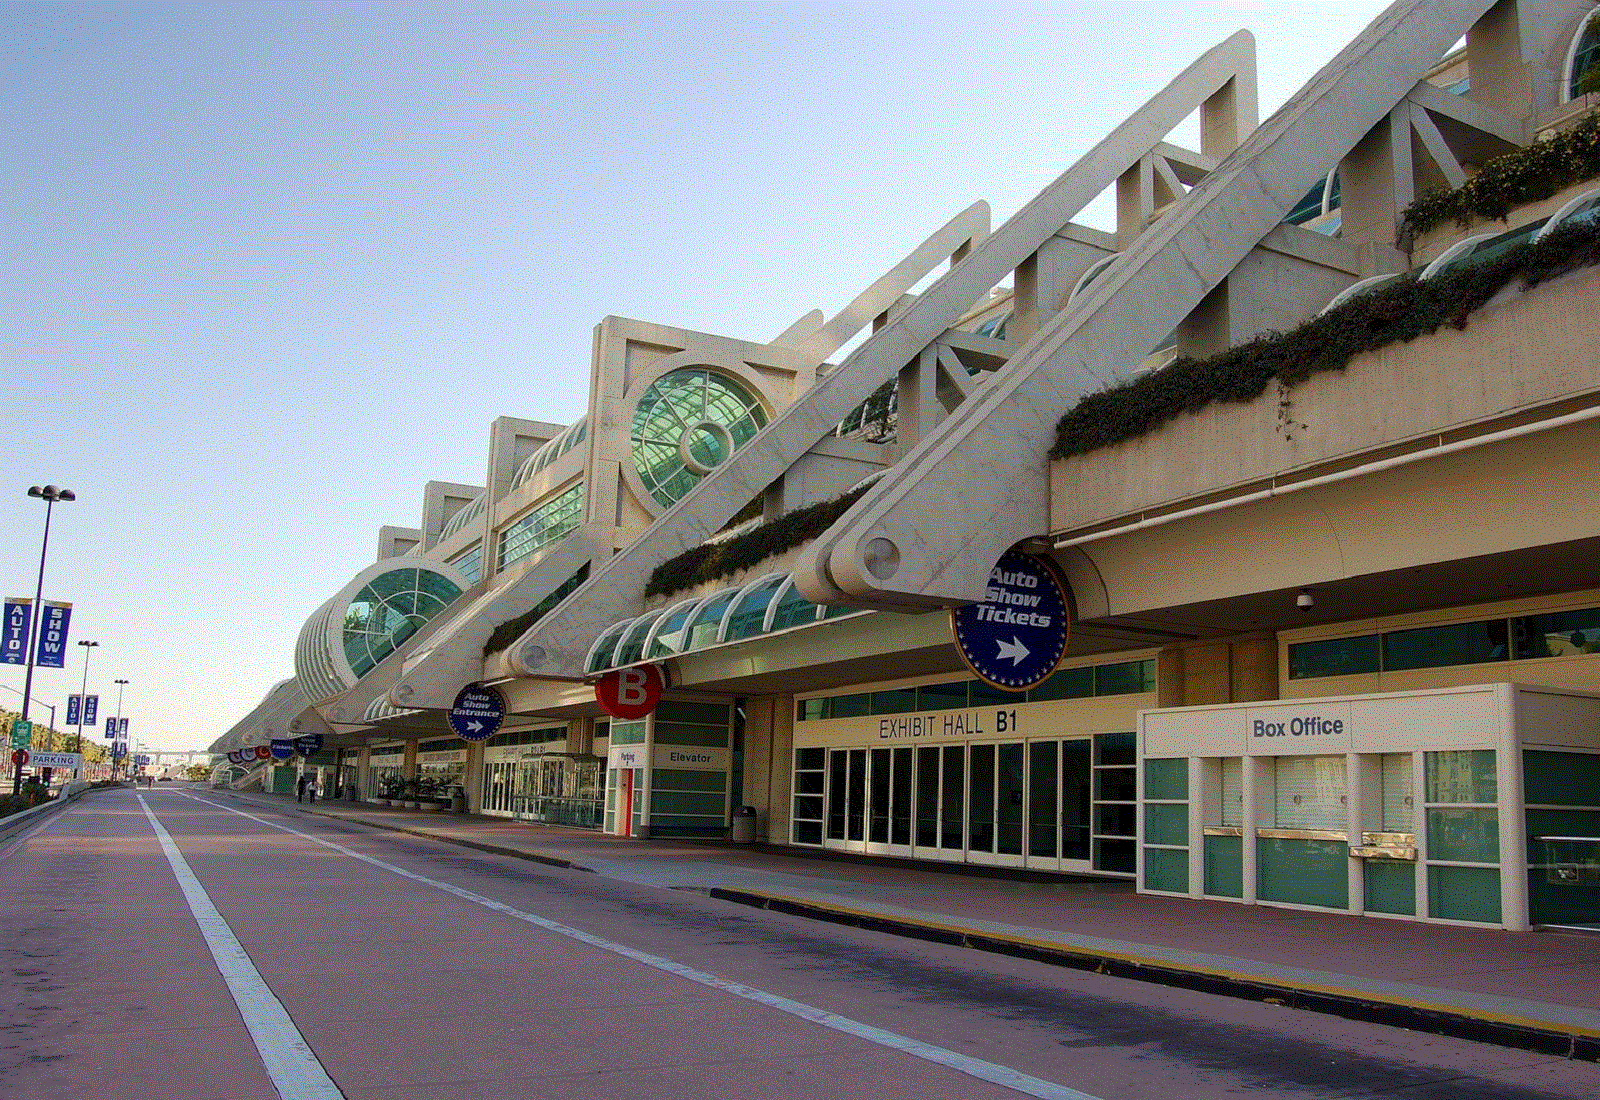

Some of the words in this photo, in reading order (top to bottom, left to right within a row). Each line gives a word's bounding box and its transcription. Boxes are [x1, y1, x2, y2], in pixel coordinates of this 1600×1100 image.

[989, 567, 1038, 588] Auto
[985, 586, 1041, 607] Show
[976, 604, 1052, 628] Tickets
[9, 605, 24, 650] AUTO
[44, 608, 63, 653] SHOW
[464, 693, 490, 701] Auto
[618, 668, 648, 705] B
[86, 698, 95, 720] SHOW
[453, 708, 500, 718] Entrance
[462, 700, 491, 709] Show
[879, 716, 937, 738] EXHIBIT
[943, 712, 984, 736] HALL
[996, 709, 1017, 733] B1
[1253, 719, 1286, 738] Box
[1290, 716, 1344, 736] Office
[33, 755, 74, 765] PARKING
[670, 752, 711, 763] Elevator
